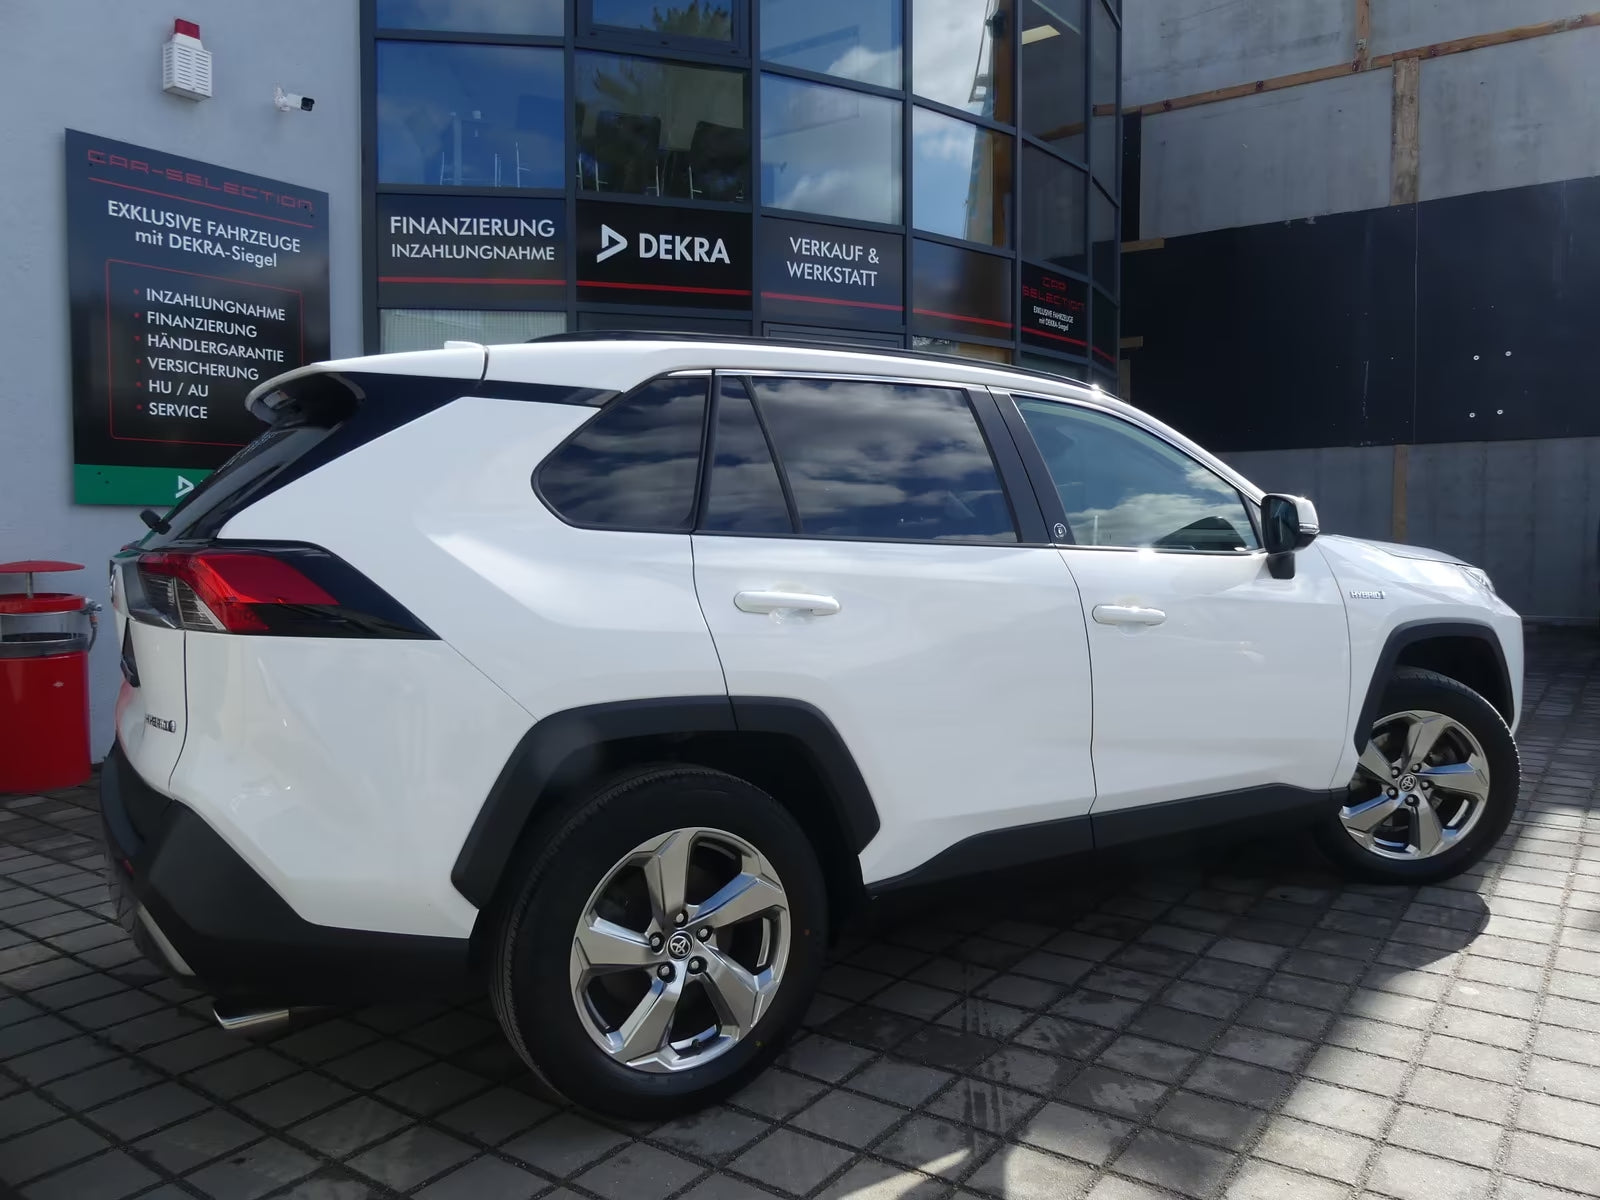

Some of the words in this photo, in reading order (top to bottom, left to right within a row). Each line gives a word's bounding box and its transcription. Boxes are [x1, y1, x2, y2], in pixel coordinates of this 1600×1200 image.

[107, 199, 202, 233] EXKLUSIVE
[206, 221, 301, 253] FAHRZEUGE
[389, 215, 556, 238] FINANZIERUNG
[135, 229, 163, 246] mit
[168, 233, 278, 268] DEKRA-Siegel
[390, 242, 556, 261] INZAHLUNGNAHME
[638, 231, 732, 264] DEKRA
[789, 236, 864, 262] VERKAUF
[867, 247, 880, 264] &
[786, 260, 878, 287] WERKSTATT
[146, 288, 286, 321] INZAHLUNGNAHME
[146, 310, 258, 338] FINANZIERUNG
[147, 332, 285, 363] HÄNDLERGARANTIE
[147, 356, 260, 381] VERSICHERUNG
[148, 380, 172, 394] HU
[187, 384, 209, 398] AU
[148, 402, 209, 419] SERVICE
